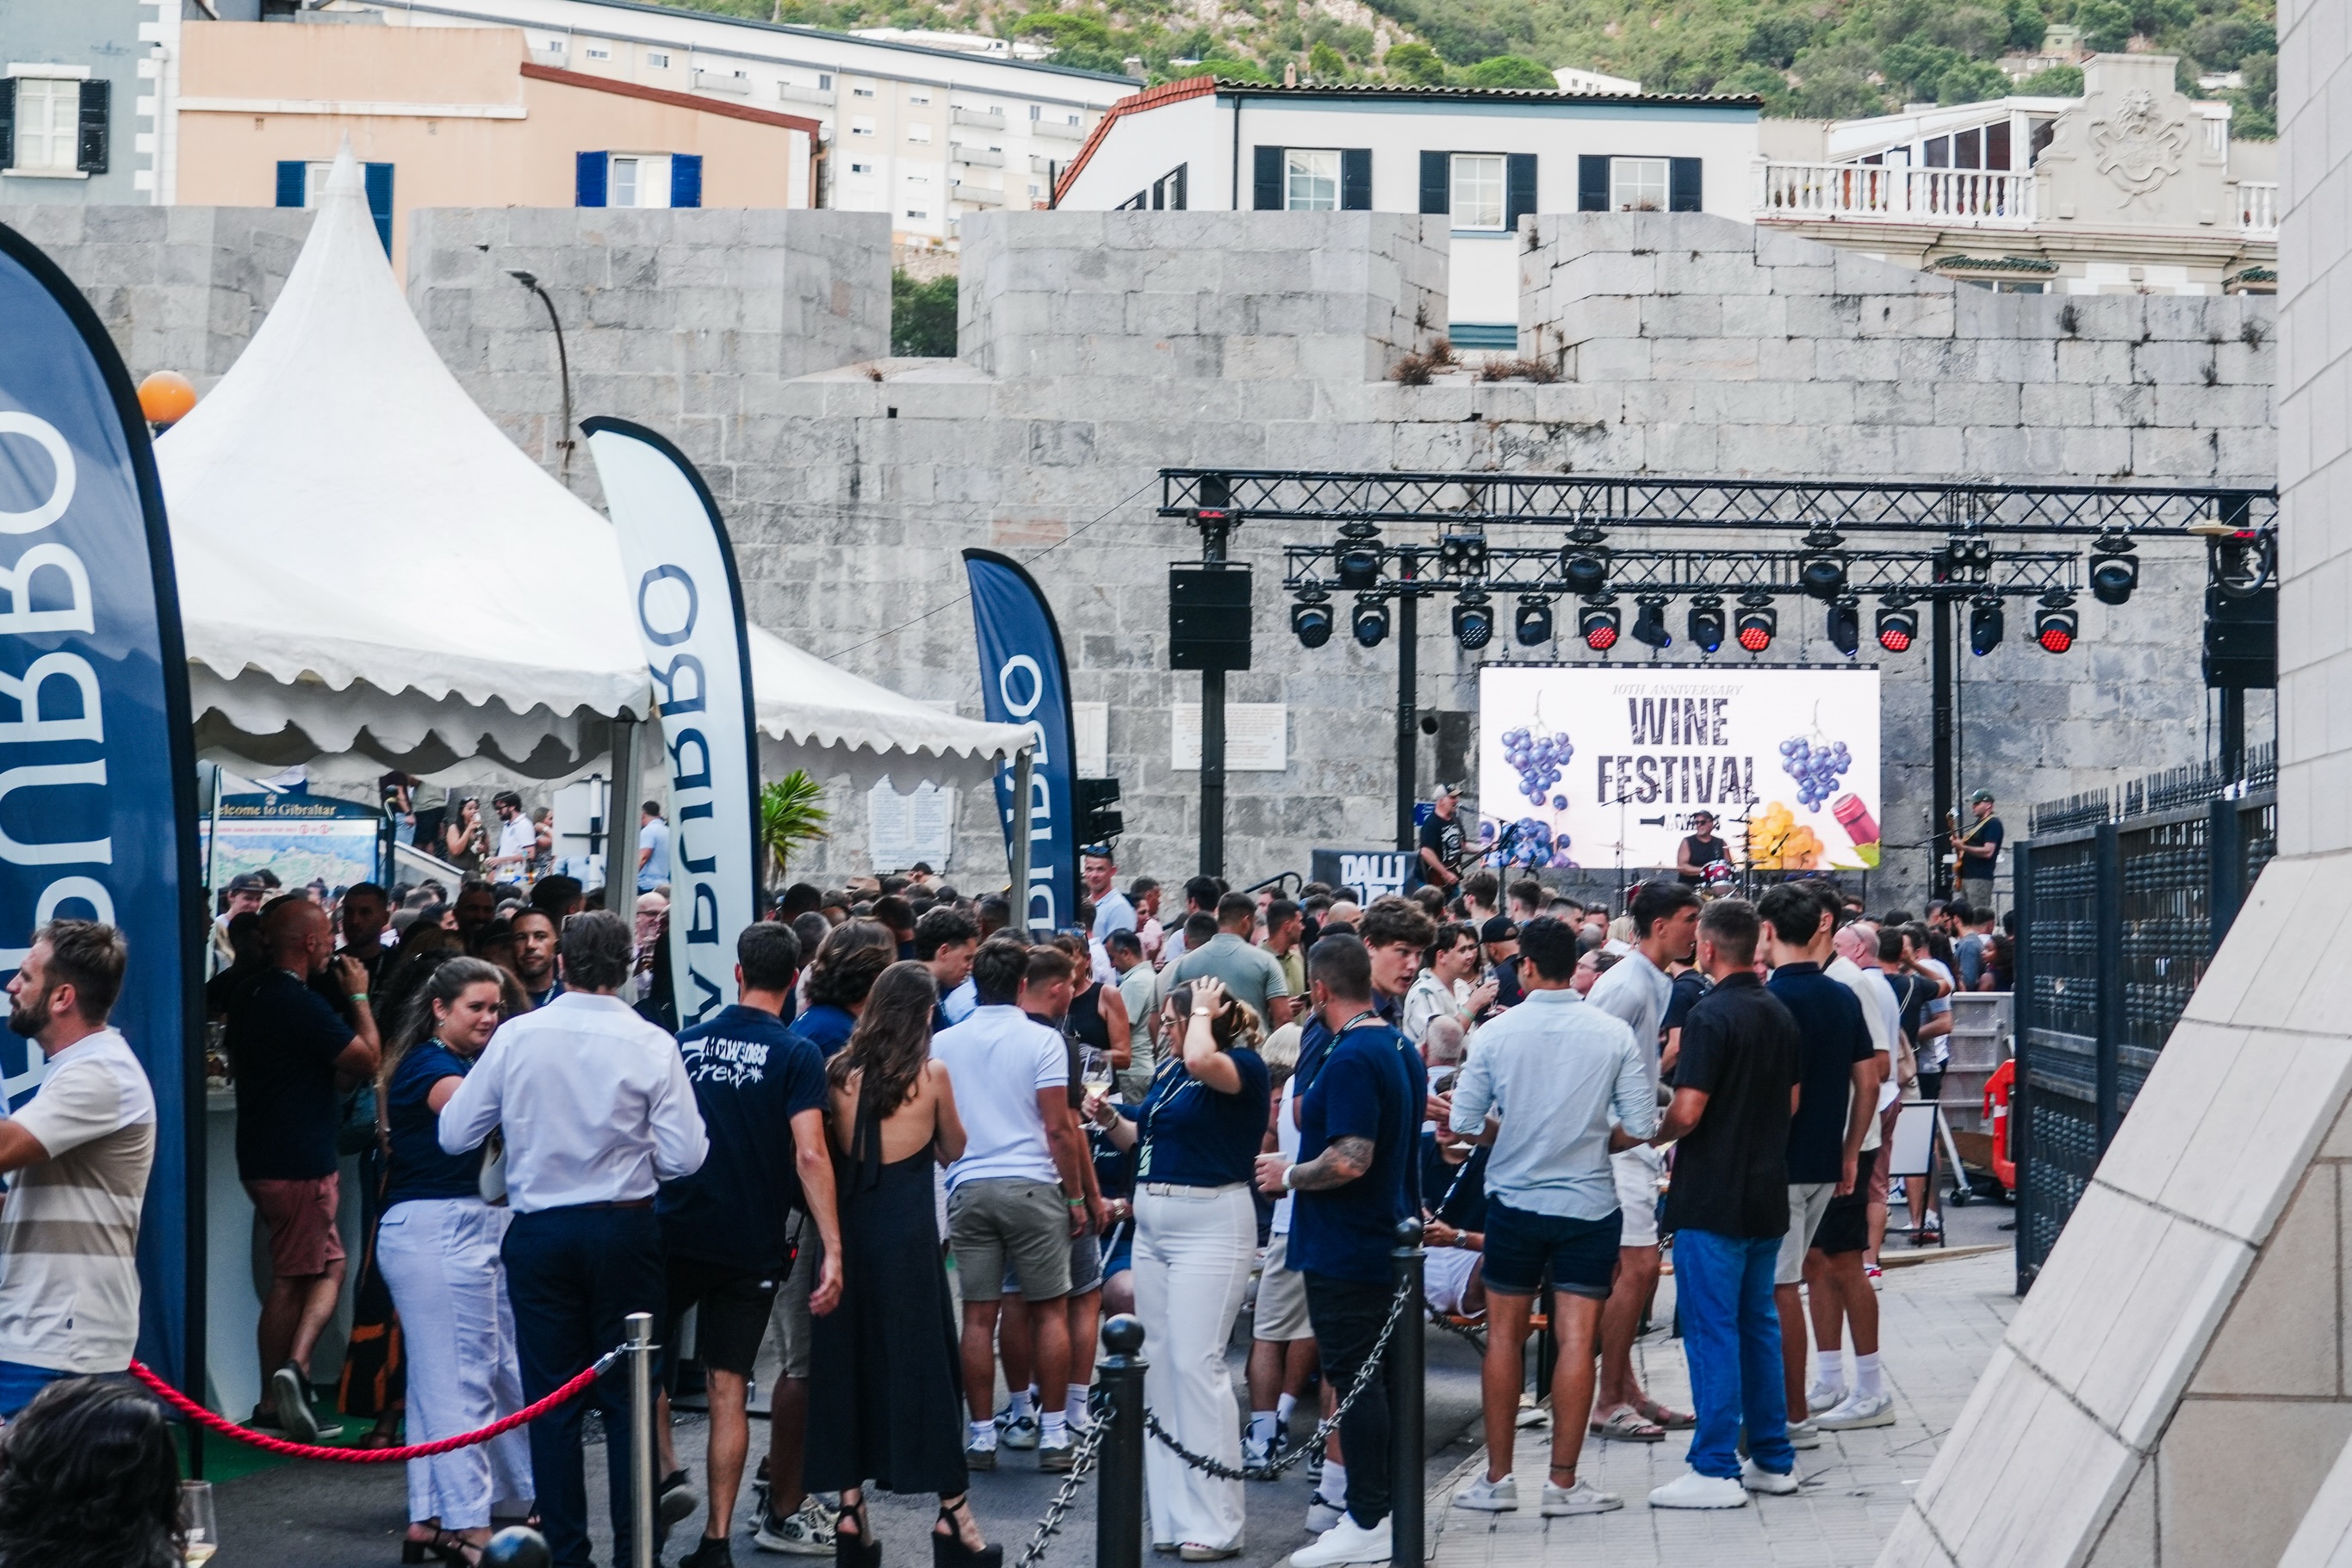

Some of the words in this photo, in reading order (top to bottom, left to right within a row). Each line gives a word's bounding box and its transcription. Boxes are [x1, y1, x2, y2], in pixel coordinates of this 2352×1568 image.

[1649, 684, 1744, 696] ANNIVERSARY
[1628, 697, 1729, 747] WINE
[1597, 755, 1760, 805] FESTIVAL
[212, 803, 261, 816] elcome
[264, 804, 277, 816] to
[278, 803, 338, 816] Gibraltar
